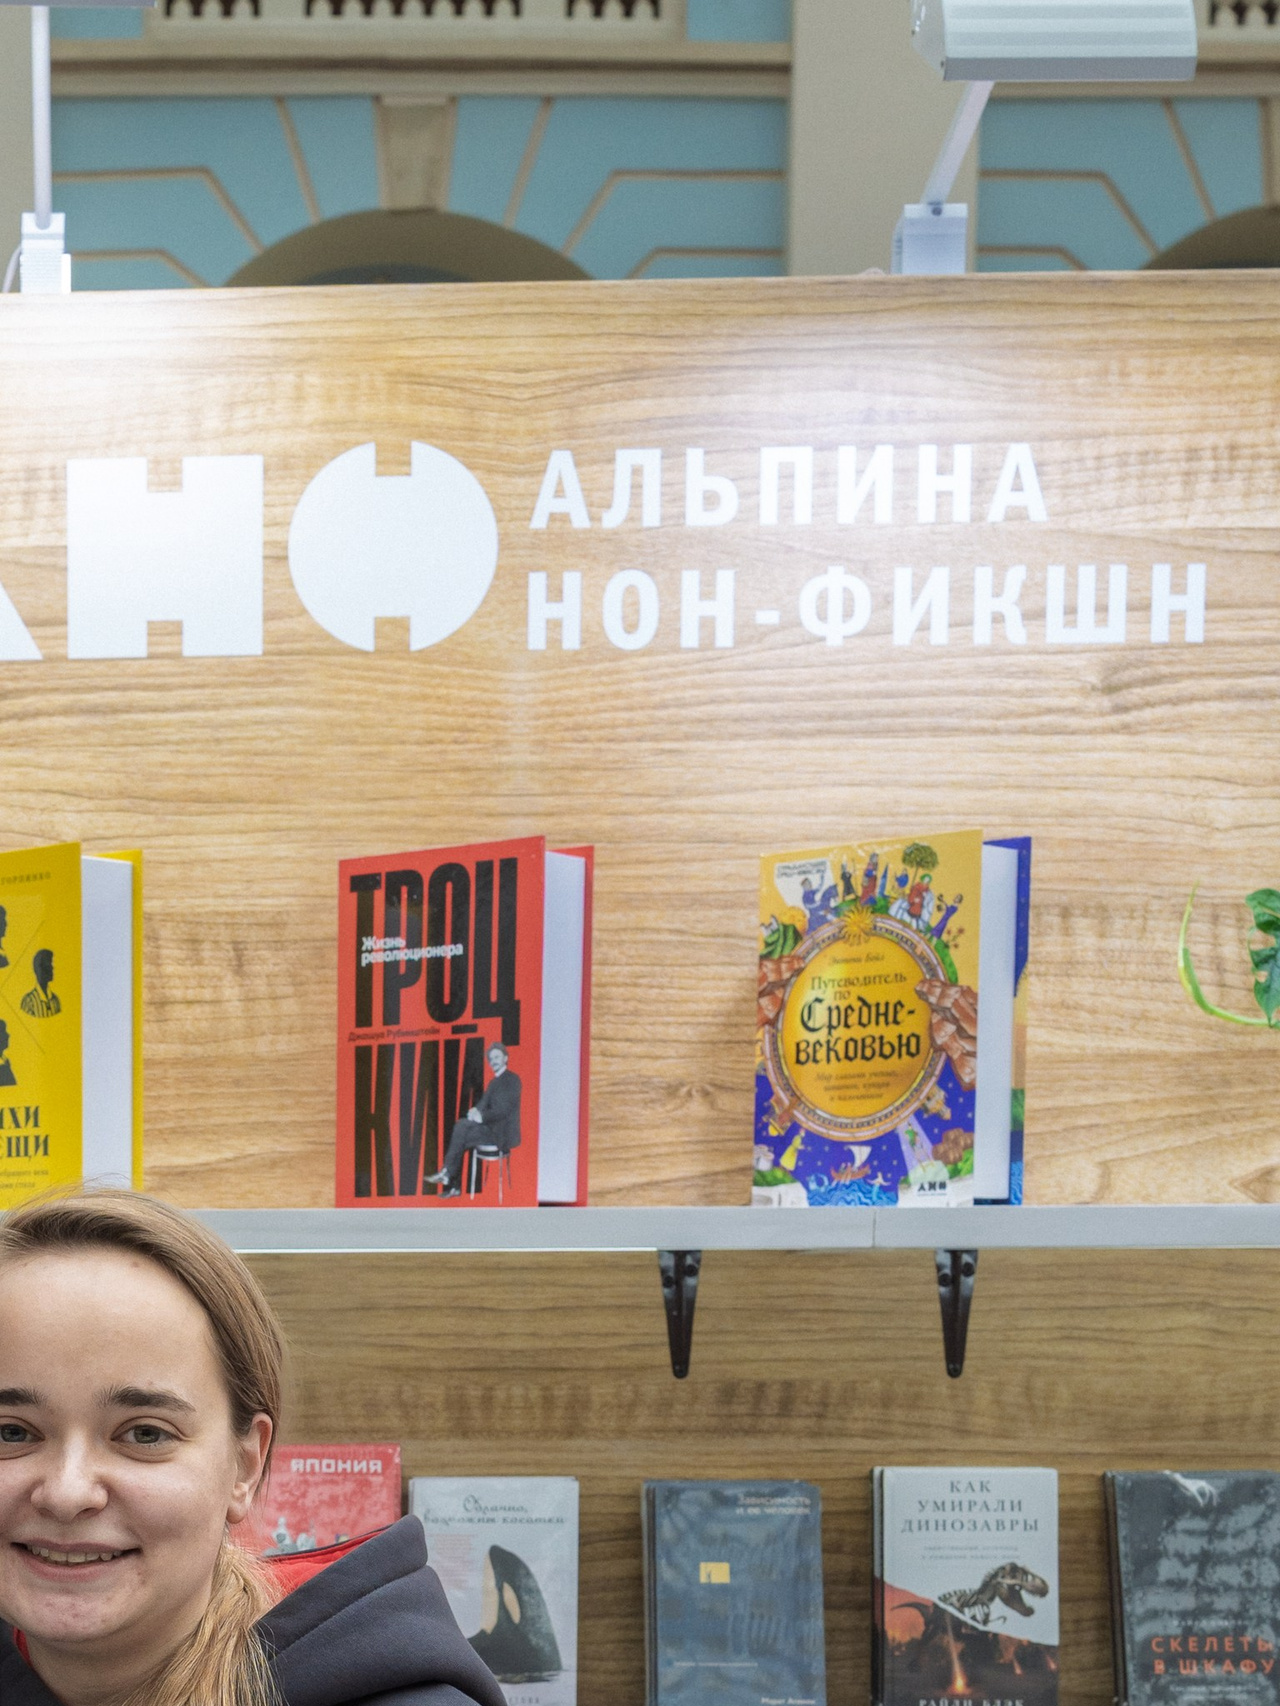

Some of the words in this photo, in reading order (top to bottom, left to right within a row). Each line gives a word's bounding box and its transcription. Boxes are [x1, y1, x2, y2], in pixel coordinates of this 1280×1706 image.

[527, 443, 1050, 530] АЛЬПИНА
[526, 562, 1208, 651] НОН-ФИКШН
[350, 857, 521, 1046] ТРОЦ
[361, 936, 407, 951] Жизнь
[361, 942, 464, 967] революционера
[810, 973, 908, 994] Путеводитель
[834, 991, 852, 1001] по
[801, 996, 917, 1036] Средне-
[795, 1033, 921, 1067] вековью
[290, 1457, 383, 1475] ЯПОНИЯ
[949, 1480, 991, 1494] КАК
[917, 1500, 1023, 1513] УМИРАЛИ
[900, 1518, 1039, 1534] ДИНОЗАВРЫ
[1150, 1636, 1275, 1653] СКЕЛЕТЫ
[1153, 1659, 1166, 1675] В
[1179, 1658, 1275, 1675] ШКАФУ
